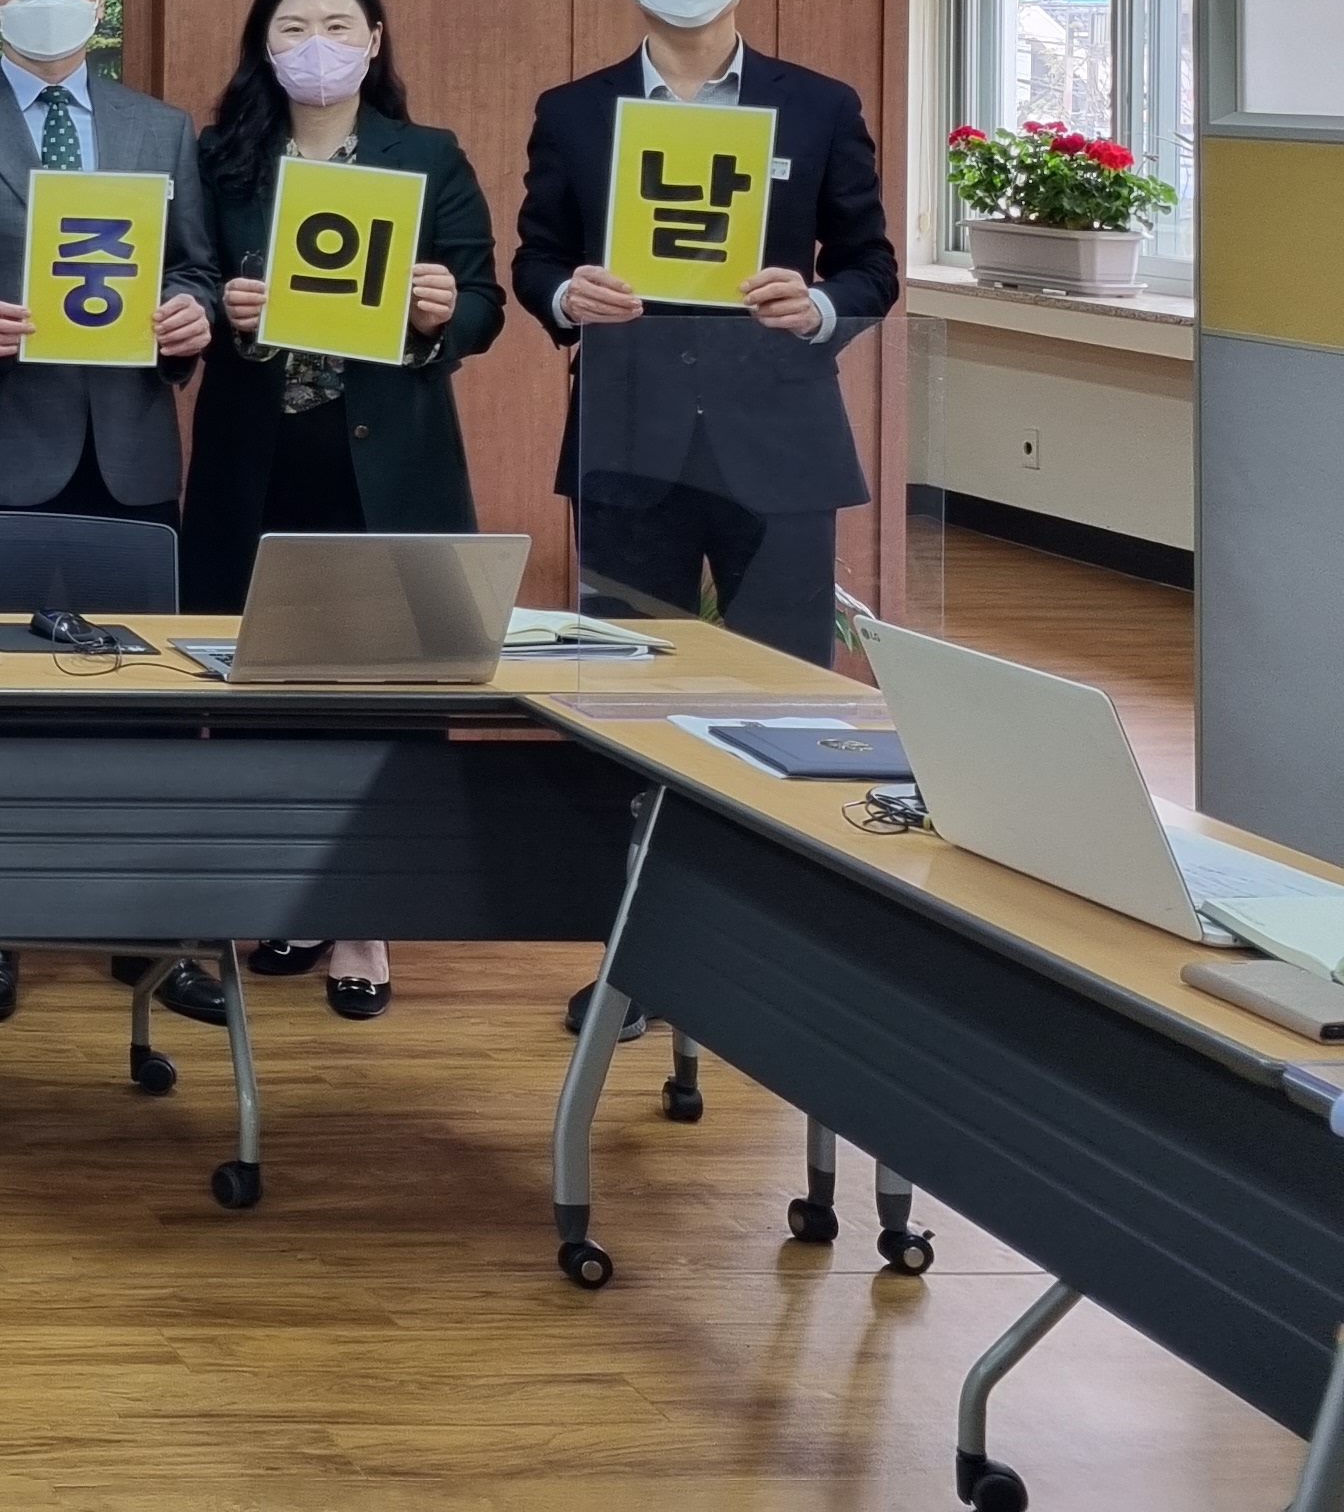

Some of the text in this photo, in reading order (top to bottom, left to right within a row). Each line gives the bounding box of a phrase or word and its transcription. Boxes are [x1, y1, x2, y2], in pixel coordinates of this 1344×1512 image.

[290, 211, 395, 308] 의
[640, 149, 752, 263] 날
[51, 217, 139, 328] 중
